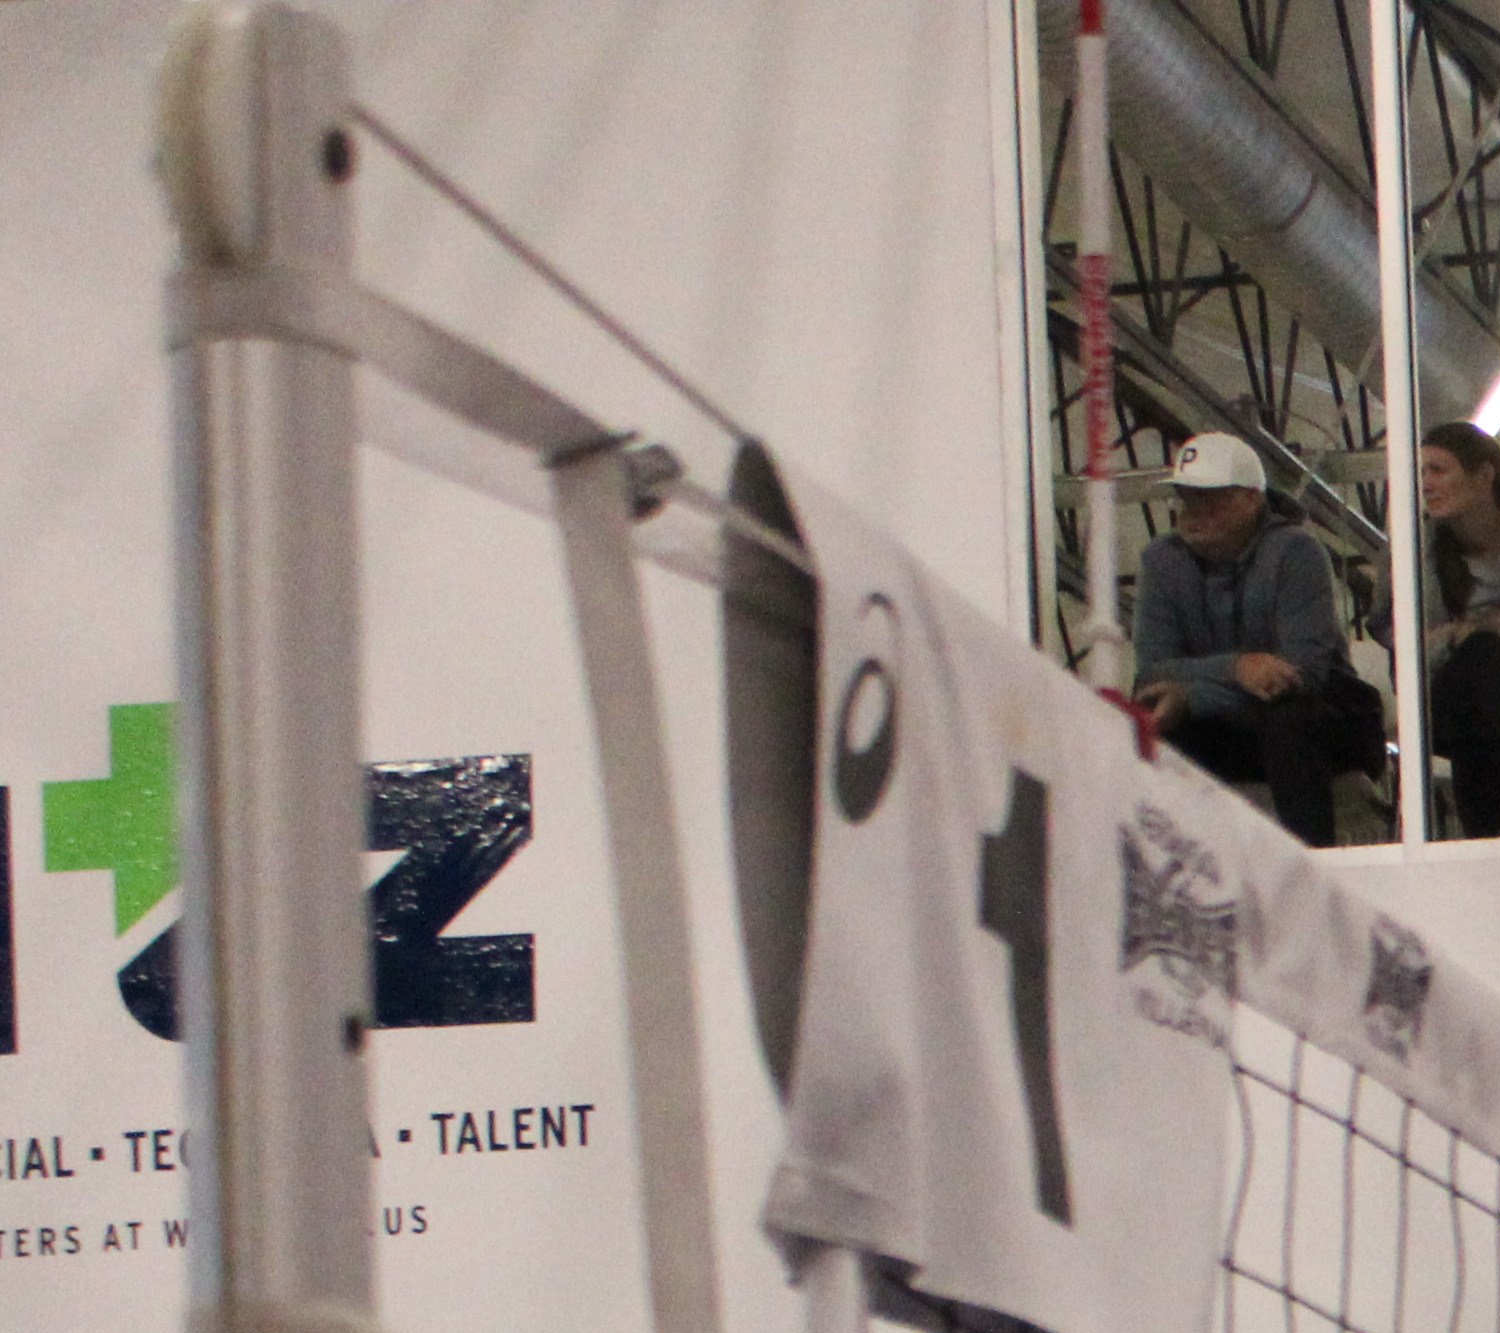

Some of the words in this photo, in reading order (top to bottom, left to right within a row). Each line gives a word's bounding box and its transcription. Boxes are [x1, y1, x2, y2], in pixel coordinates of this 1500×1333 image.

[0, 1134, 75, 1180] IAL
[431, 1103, 595, 1156] TALENT
[104, 1222, 143, 1252] AT
